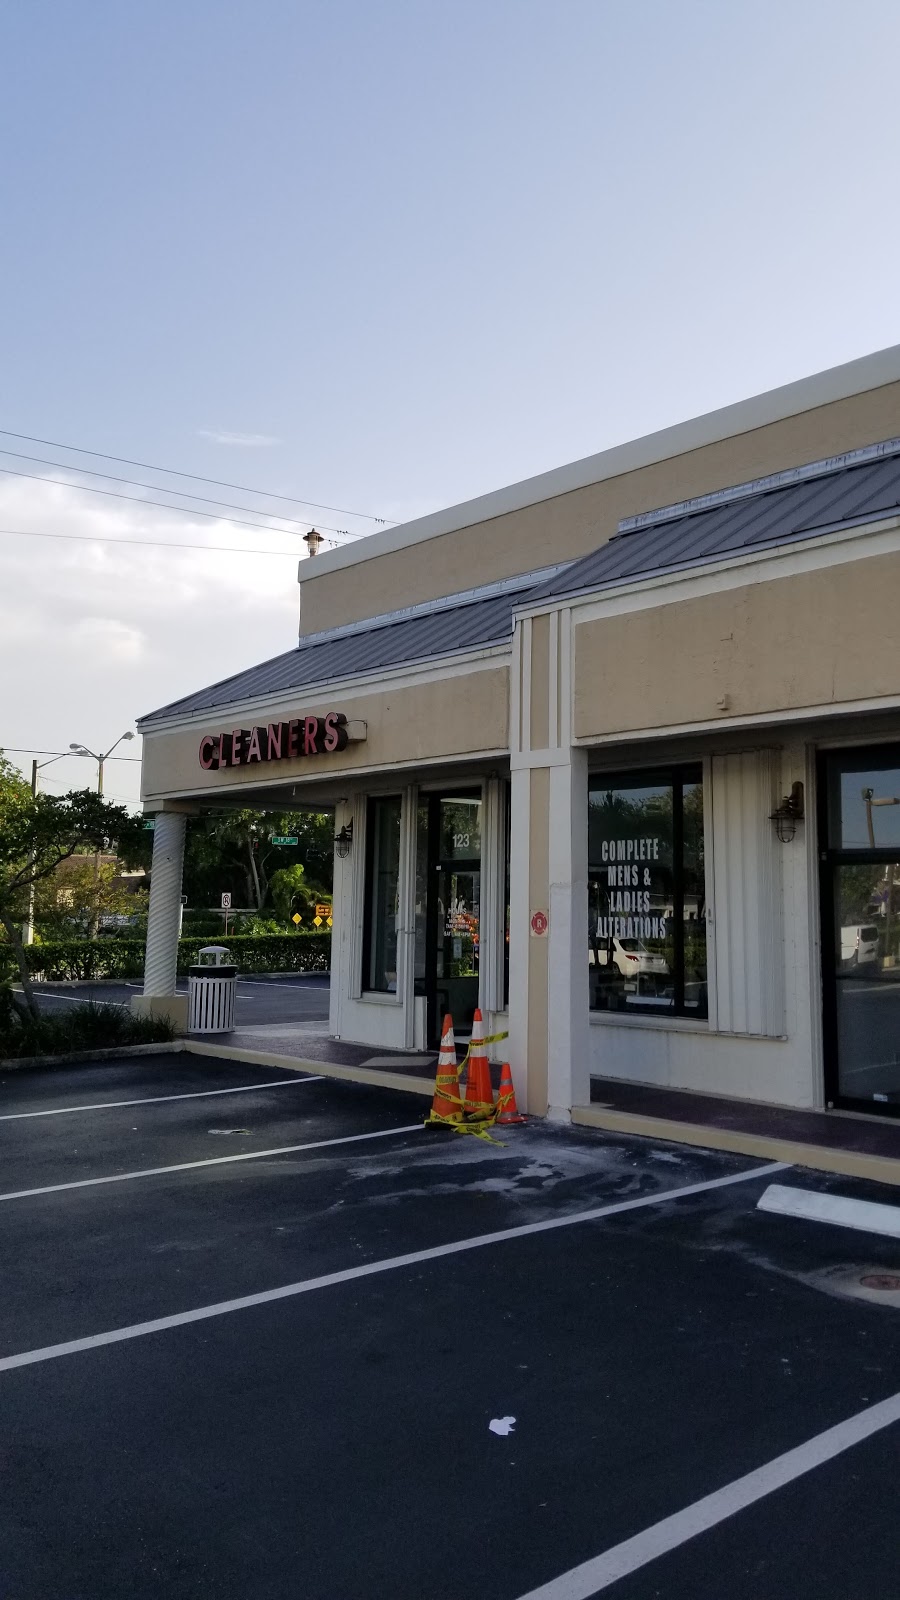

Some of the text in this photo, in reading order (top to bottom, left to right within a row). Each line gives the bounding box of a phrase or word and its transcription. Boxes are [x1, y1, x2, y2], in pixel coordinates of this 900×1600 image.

[199, 711, 348, 771] CLEANERS
[452, 833, 470, 848] 123
[601, 838, 659, 862] COMPLETE
[607, 864, 652, 887] MENS &
[610, 890, 651, 913] LADIES
[595, 916, 666, 940] ALTERATIONS
